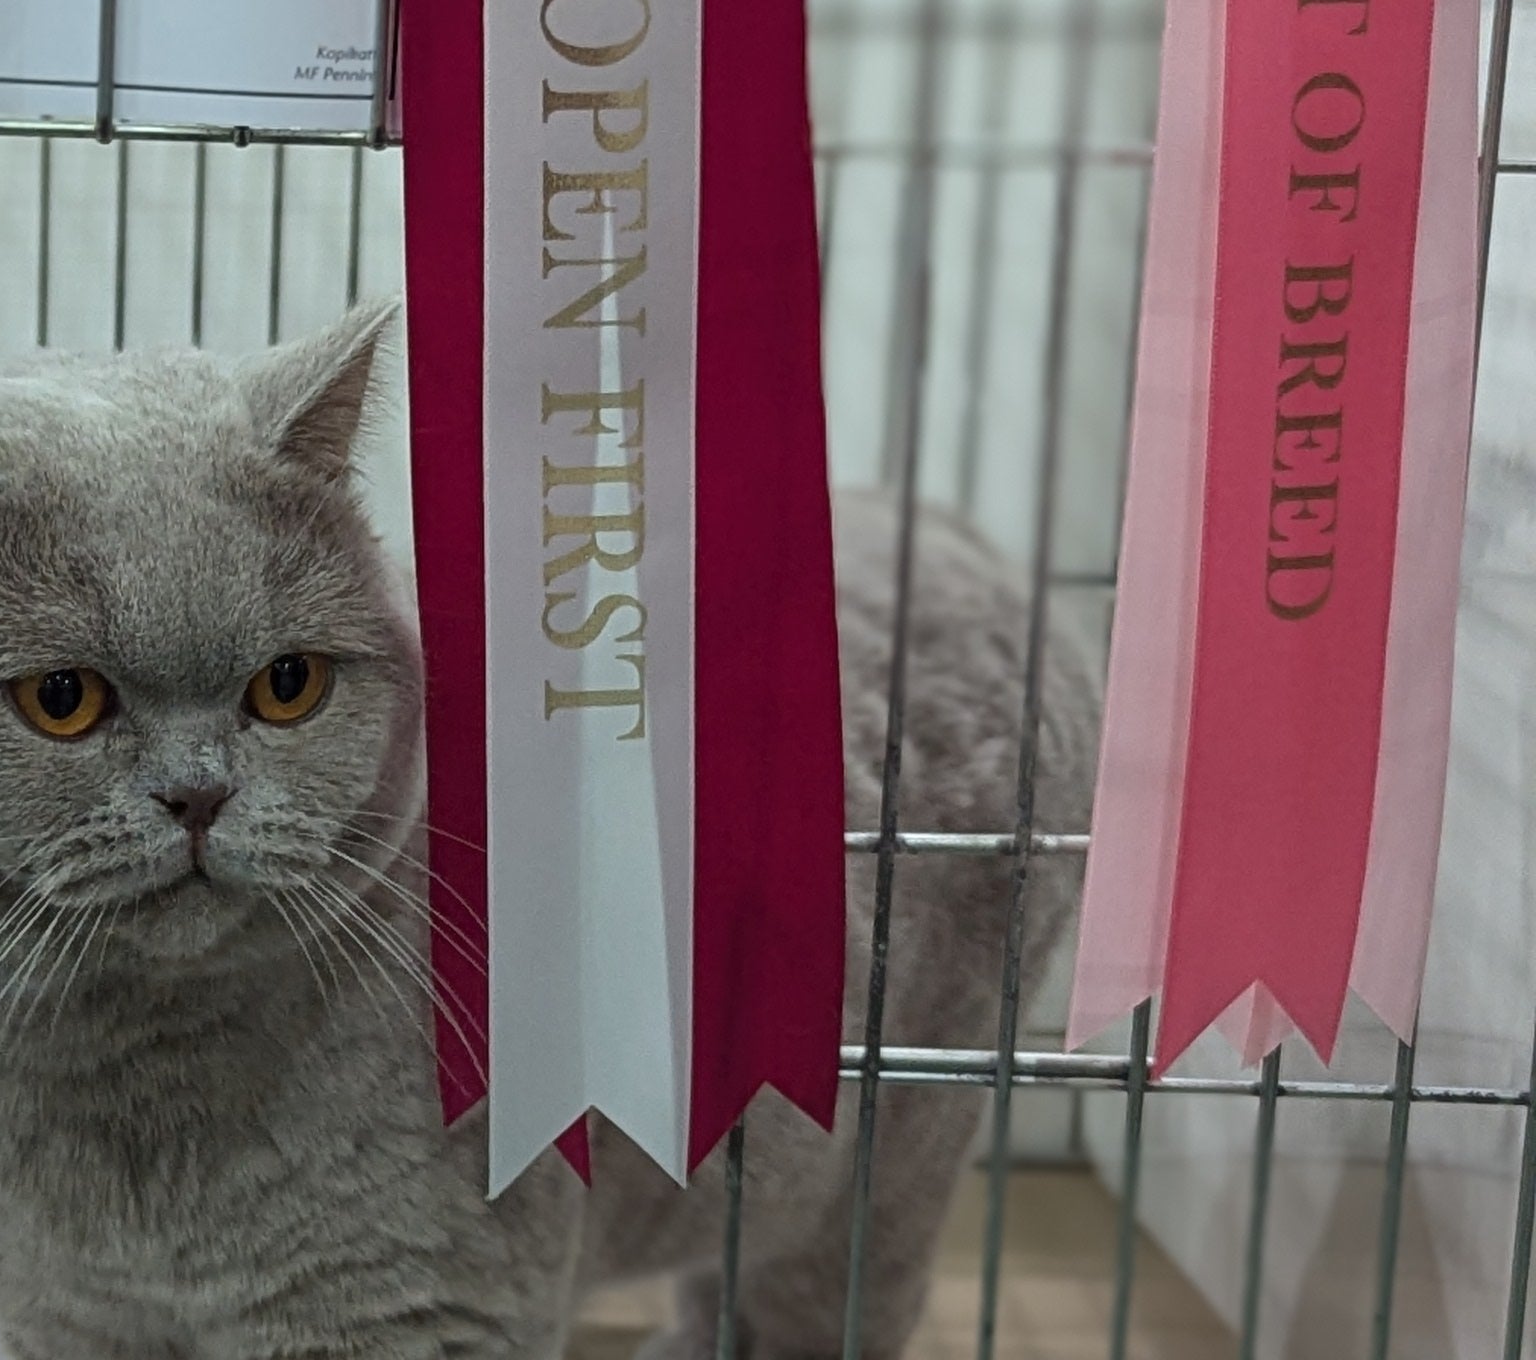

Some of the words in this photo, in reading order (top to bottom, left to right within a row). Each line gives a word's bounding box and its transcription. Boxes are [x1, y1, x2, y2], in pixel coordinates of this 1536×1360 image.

[1286, 70, 1367, 224] OF
[540, 378, 649, 742] FIRST
[1263, 253, 1356, 624] BREED
